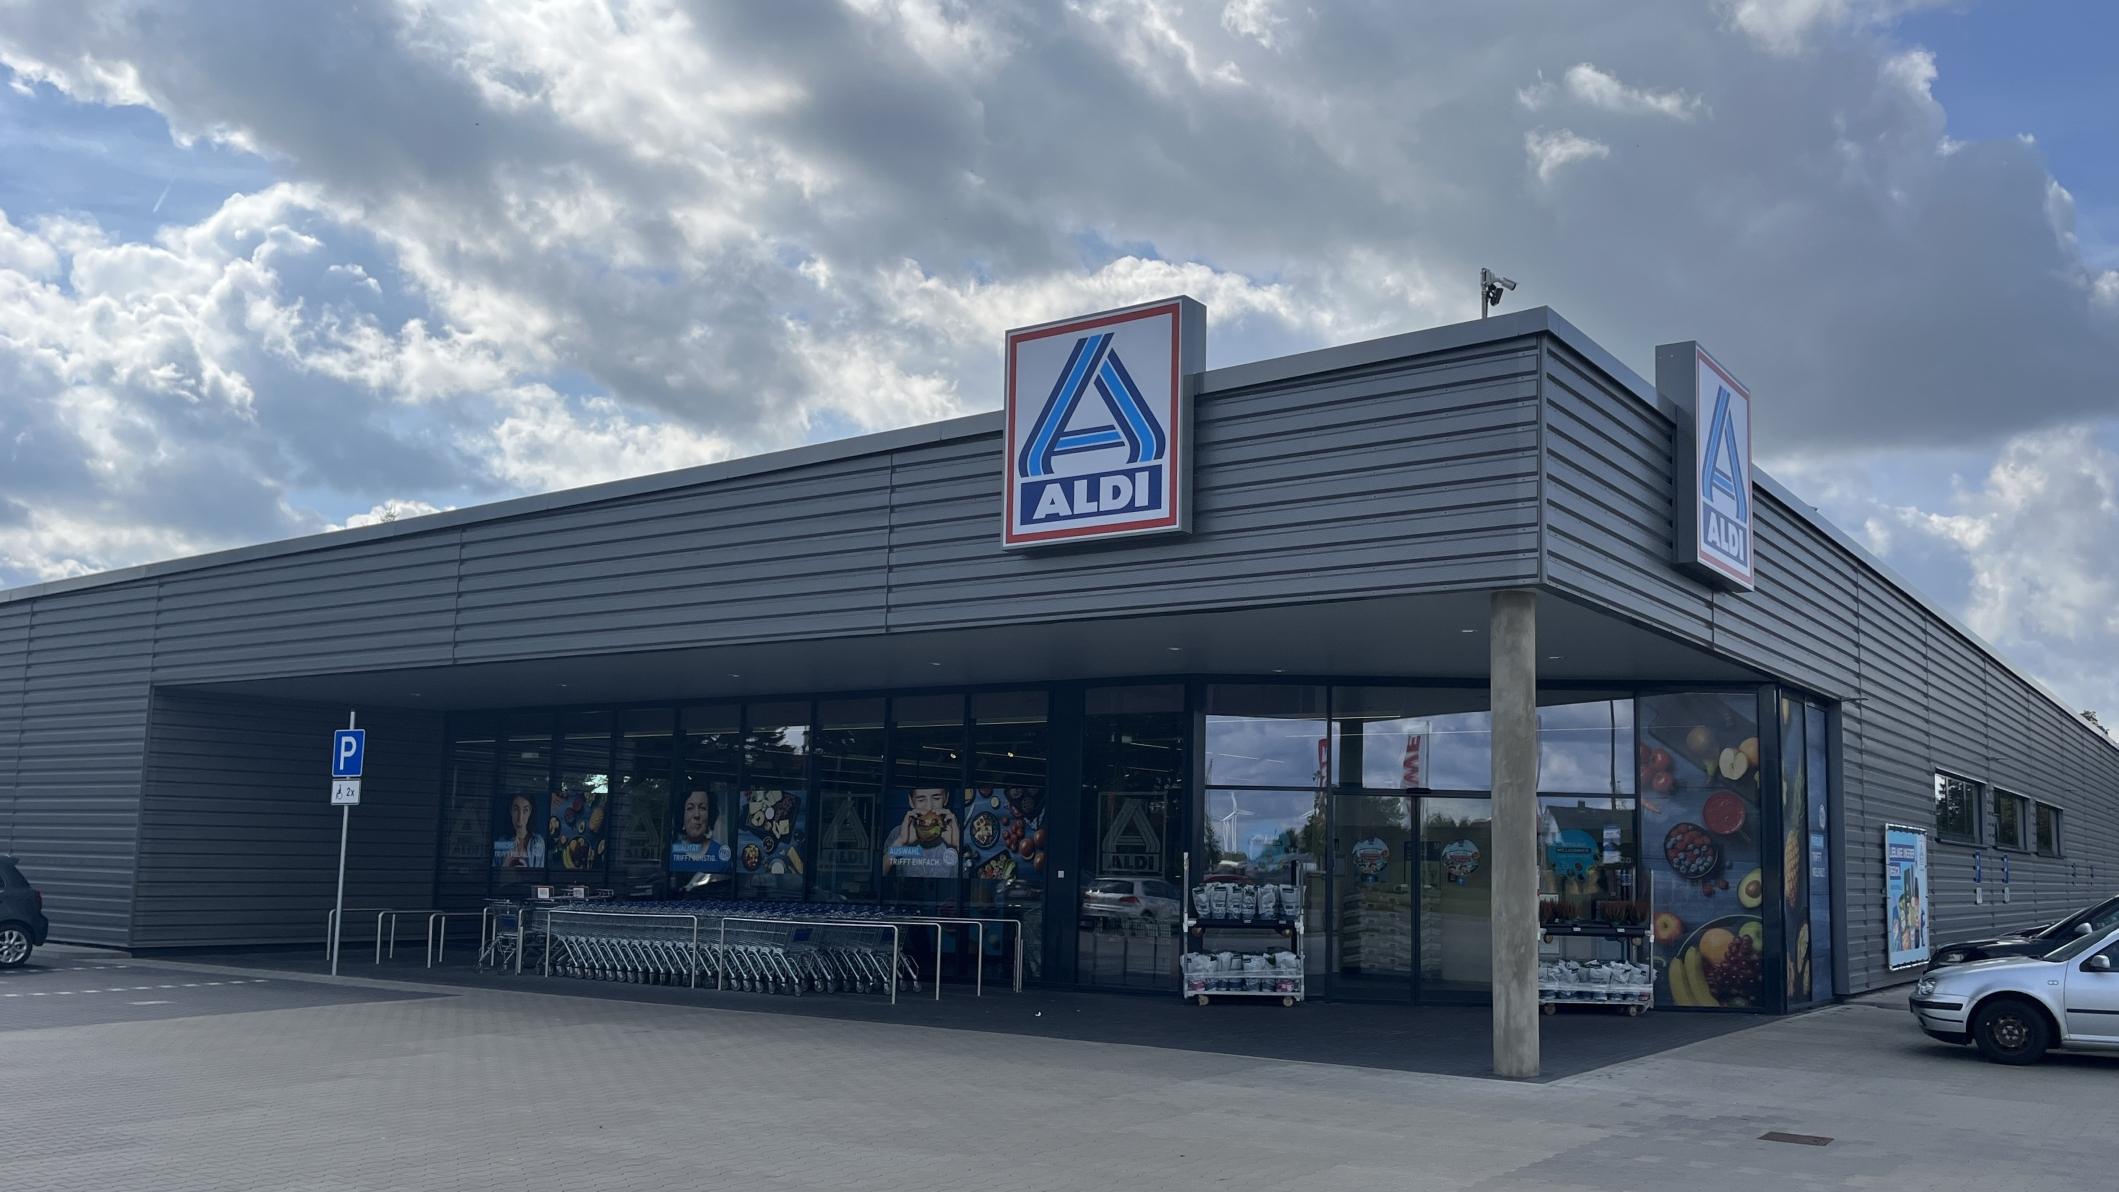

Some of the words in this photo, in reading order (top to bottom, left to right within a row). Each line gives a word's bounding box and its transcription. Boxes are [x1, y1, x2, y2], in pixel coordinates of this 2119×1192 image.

[1032, 471, 1149, 519] ALDI
[1707, 511, 1745, 562] ALDI
[339, 736, 357, 770] P
[889, 847, 920, 856] AUSWAHL
[889, 858, 910, 866] TRIFFT
[1108, 855, 1154, 869] ALDI
